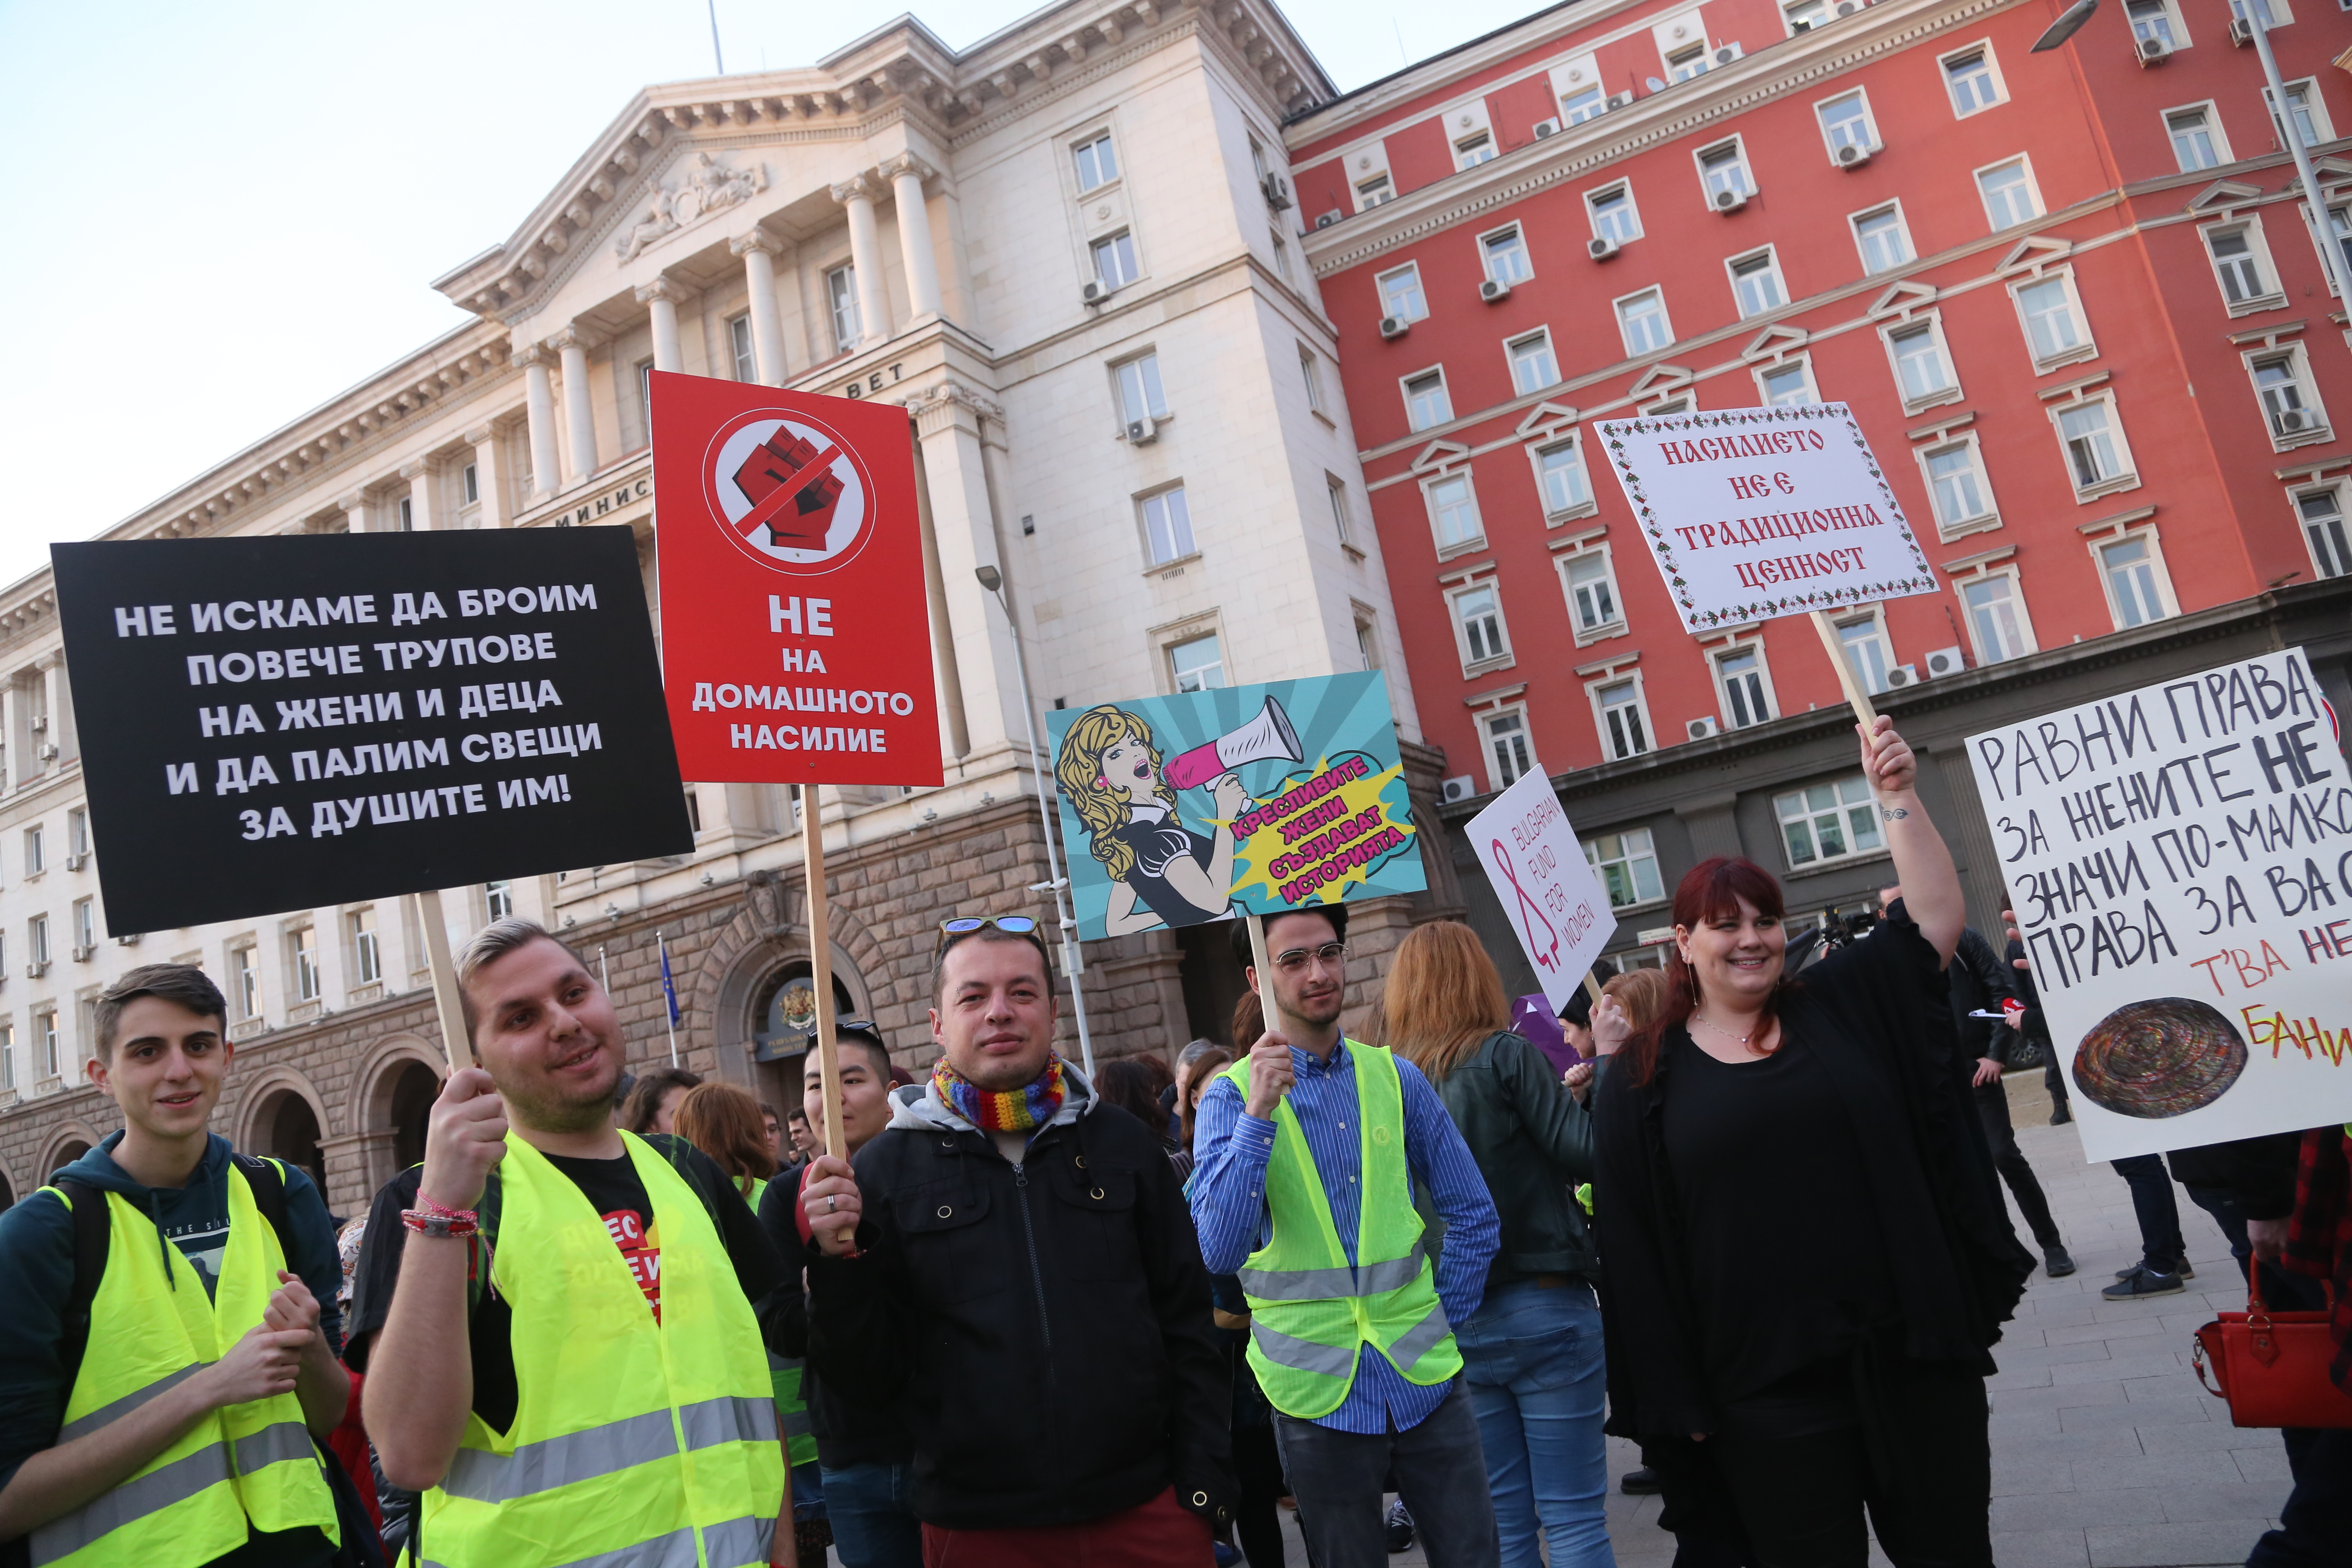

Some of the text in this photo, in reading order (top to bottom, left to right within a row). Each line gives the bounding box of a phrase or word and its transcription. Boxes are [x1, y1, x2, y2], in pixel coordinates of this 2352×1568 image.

[1659, 429, 1823, 465] НАСИЛИЕТО
[555, 474, 653, 527] МИНИС
[1675, 504, 1883, 550] ТРАДИЦИОННА
[1733, 547, 1867, 591] ЦЕННОСТ
[115, 584, 597, 637] НЕ ИСКАМЕ ДА БРОИМ
[769, 595, 833, 636] НЕ
[187, 633, 556, 685] ПОВЕЧЕ ТРУПОВЕ
[783, 648, 827, 673] НА
[199, 680, 563, 737] НА ЖЕНИ И ДЕЦА
[692, 683, 913, 716] ДОМАШНОТО
[731, 724, 886, 752] НАСИЛИЕ
[1978, 655, 2319, 801] РАВНИ ПРАВА
[166, 723, 602, 795] И ДА ПАЛИМ СВЕЩИ
[240, 774, 571, 840] ЗА ДУШИТЕ ИМ!
[1229, 756, 1369, 841] КРЕСЛИВИТЕ
[1997, 720, 2331, 862] ЗА ЖЕНИТЕ НЕ
[1269, 805, 1383, 879] СЪЗДАВАТ
[1278, 795, 1348, 845] ЖЕНИ
[1511, 793, 1561, 851] BULGARIAN
[1279, 827, 1406, 905] ИСТОРИЯТА
[1528, 845, 1556, 885] FUND
[2015, 841, 2150, 928] ЗНАЧИ
[1544, 883, 1568, 918] FOR
[1561, 898, 1595, 950] WOMEN
[2027, 899, 2178, 992] ПРАВА
[2185, 876, 2256, 935] ЗА
[166, 1225, 193, 1237] THE
